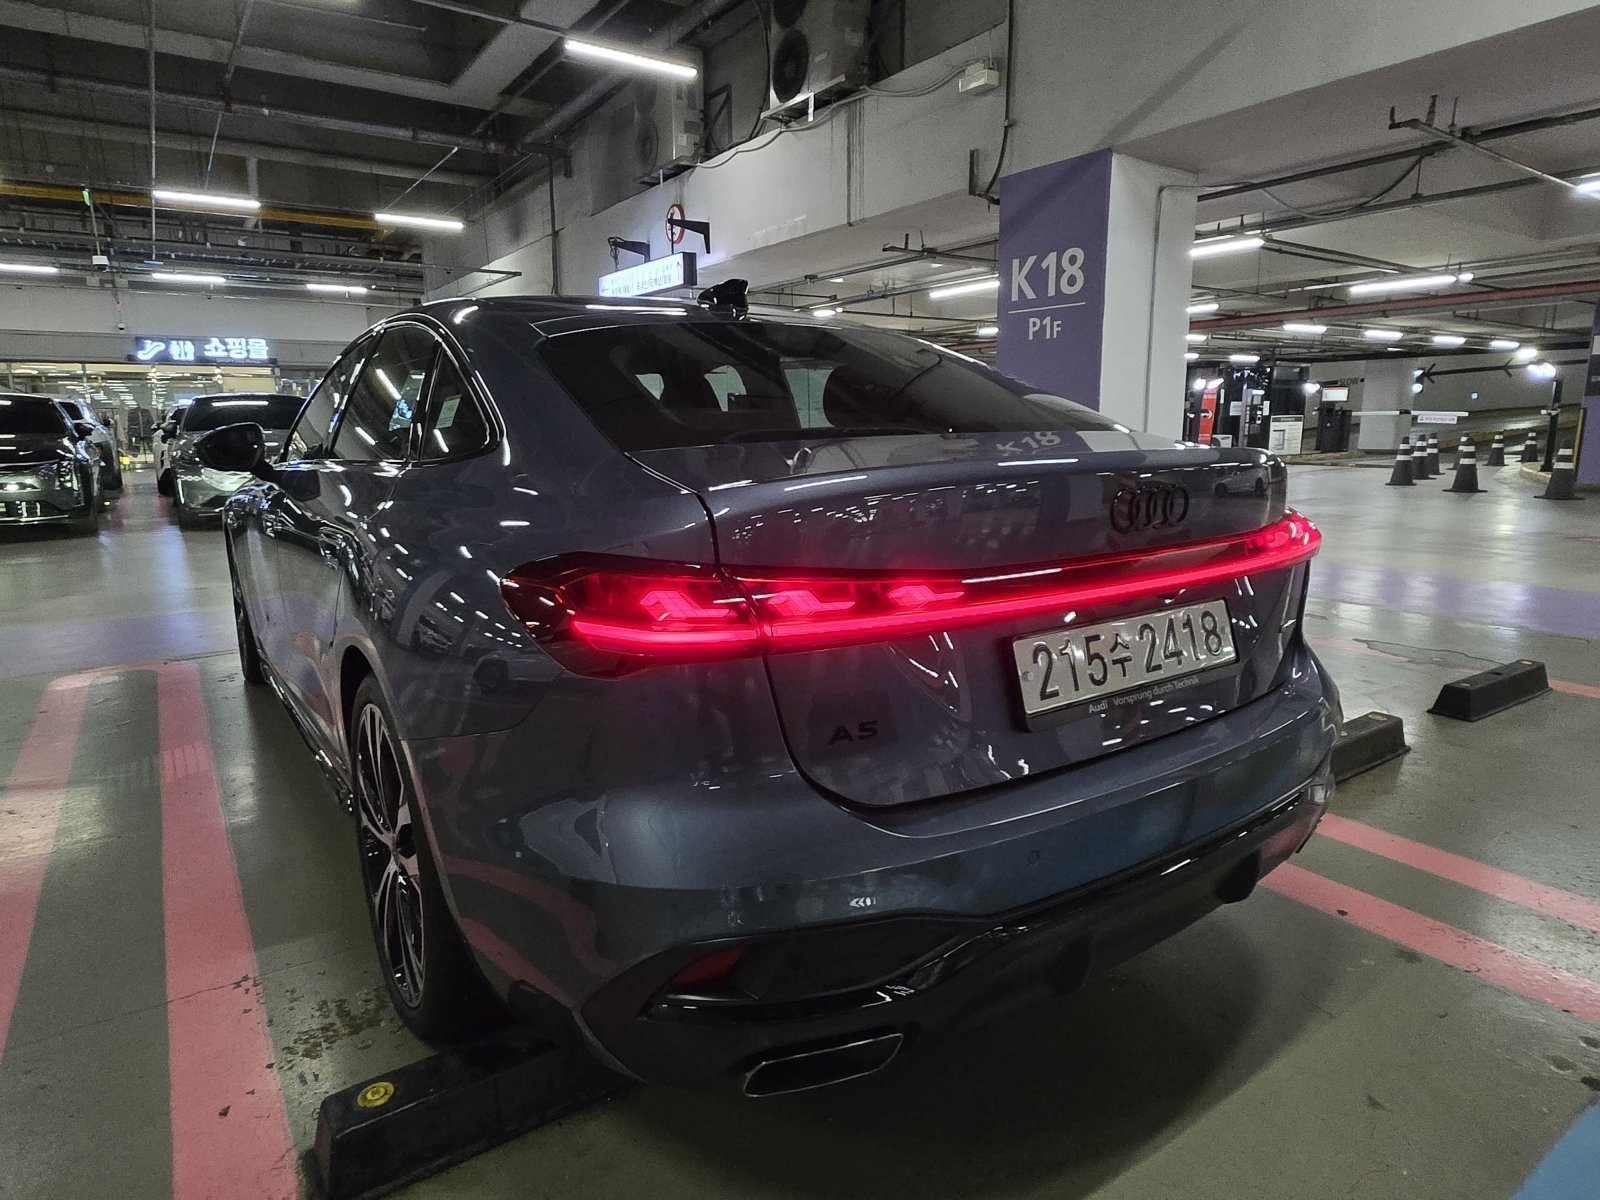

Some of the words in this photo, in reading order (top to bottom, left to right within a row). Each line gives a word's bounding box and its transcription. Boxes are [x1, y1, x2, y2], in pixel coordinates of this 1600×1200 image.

[1011, 247, 1085, 302] K18
[1028, 316, 1062, 340] P1F
[204, 337, 269, 359] 쇼핑몰
[1089, 702, 1109, 713] Audi
[1113, 689, 1153, 706] Vorsprung
[1153, 683, 1174, 696] durch
[1174, 676, 1200, 690] Technik
[828, 720, 879, 745] A5
